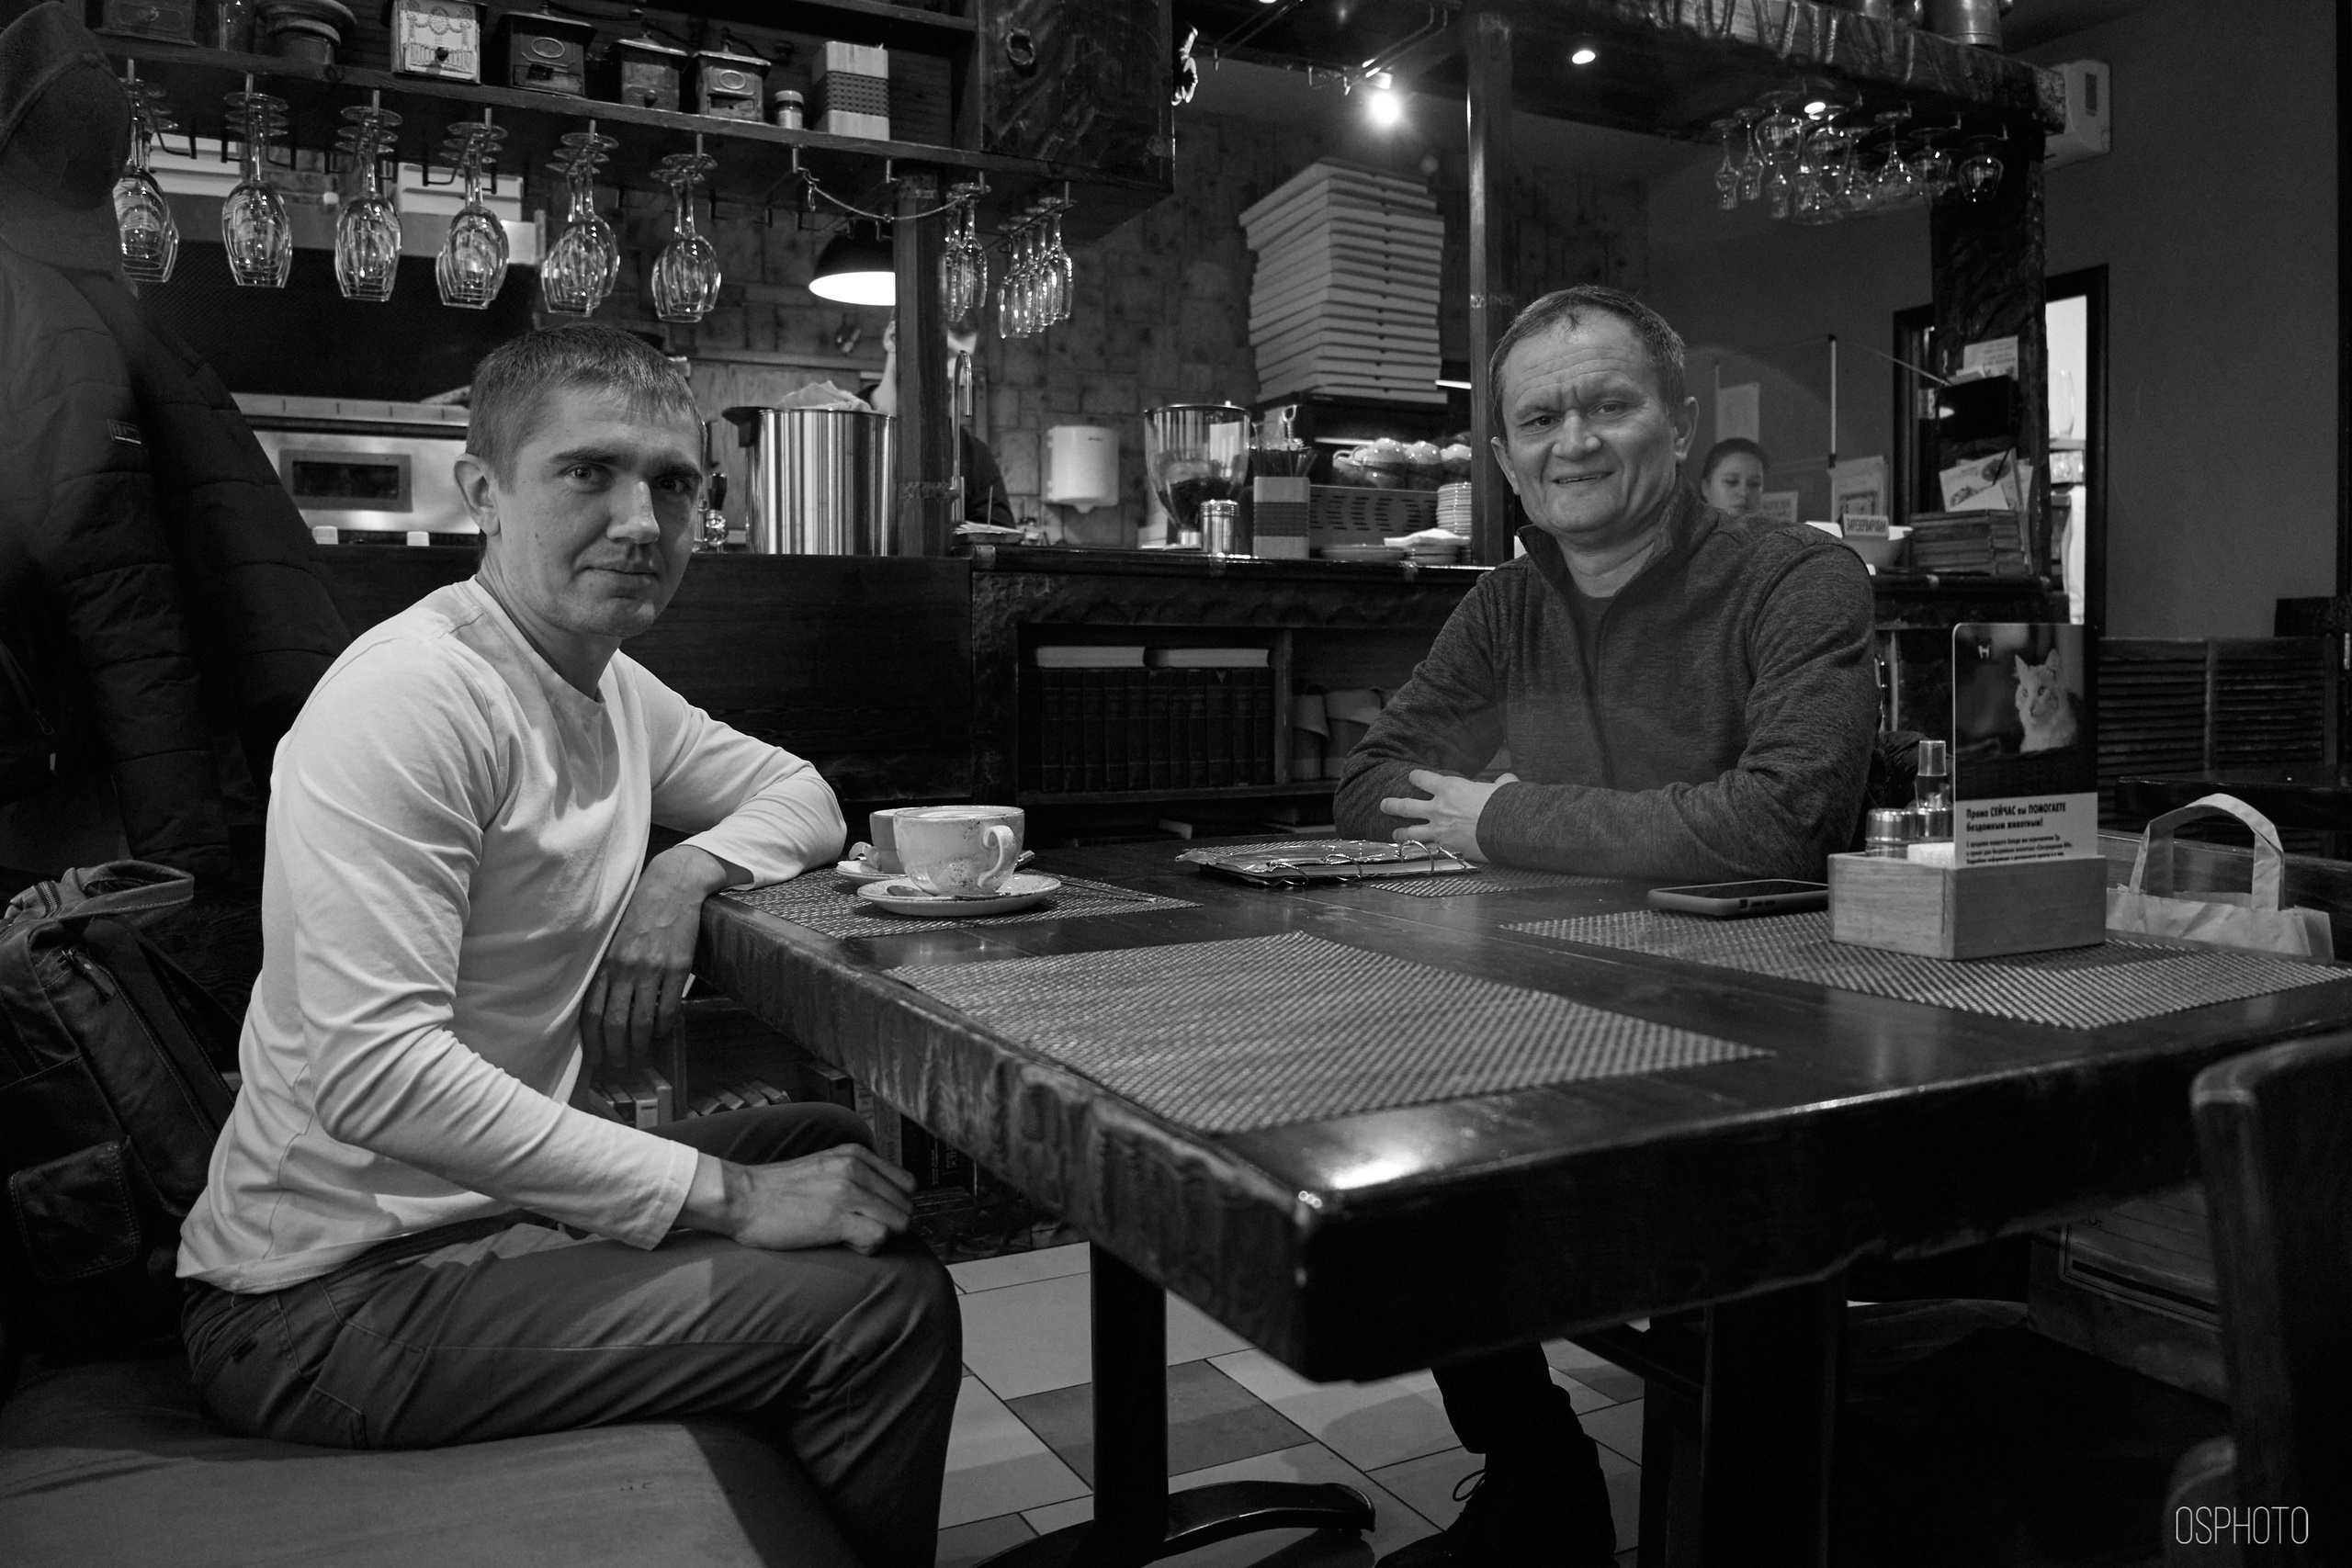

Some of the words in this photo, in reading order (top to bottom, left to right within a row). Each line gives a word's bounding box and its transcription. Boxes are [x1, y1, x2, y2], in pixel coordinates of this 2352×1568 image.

[1967, 808, 1988, 819] Прямо
[1991, 804, 2016, 817] СЕЙЧАС
[2029, 803, 2065, 814] ПОМОГАЕТЕ
[1966, 821, 2006, 832] бездомным
[2007, 818, 2043, 829] животным!
